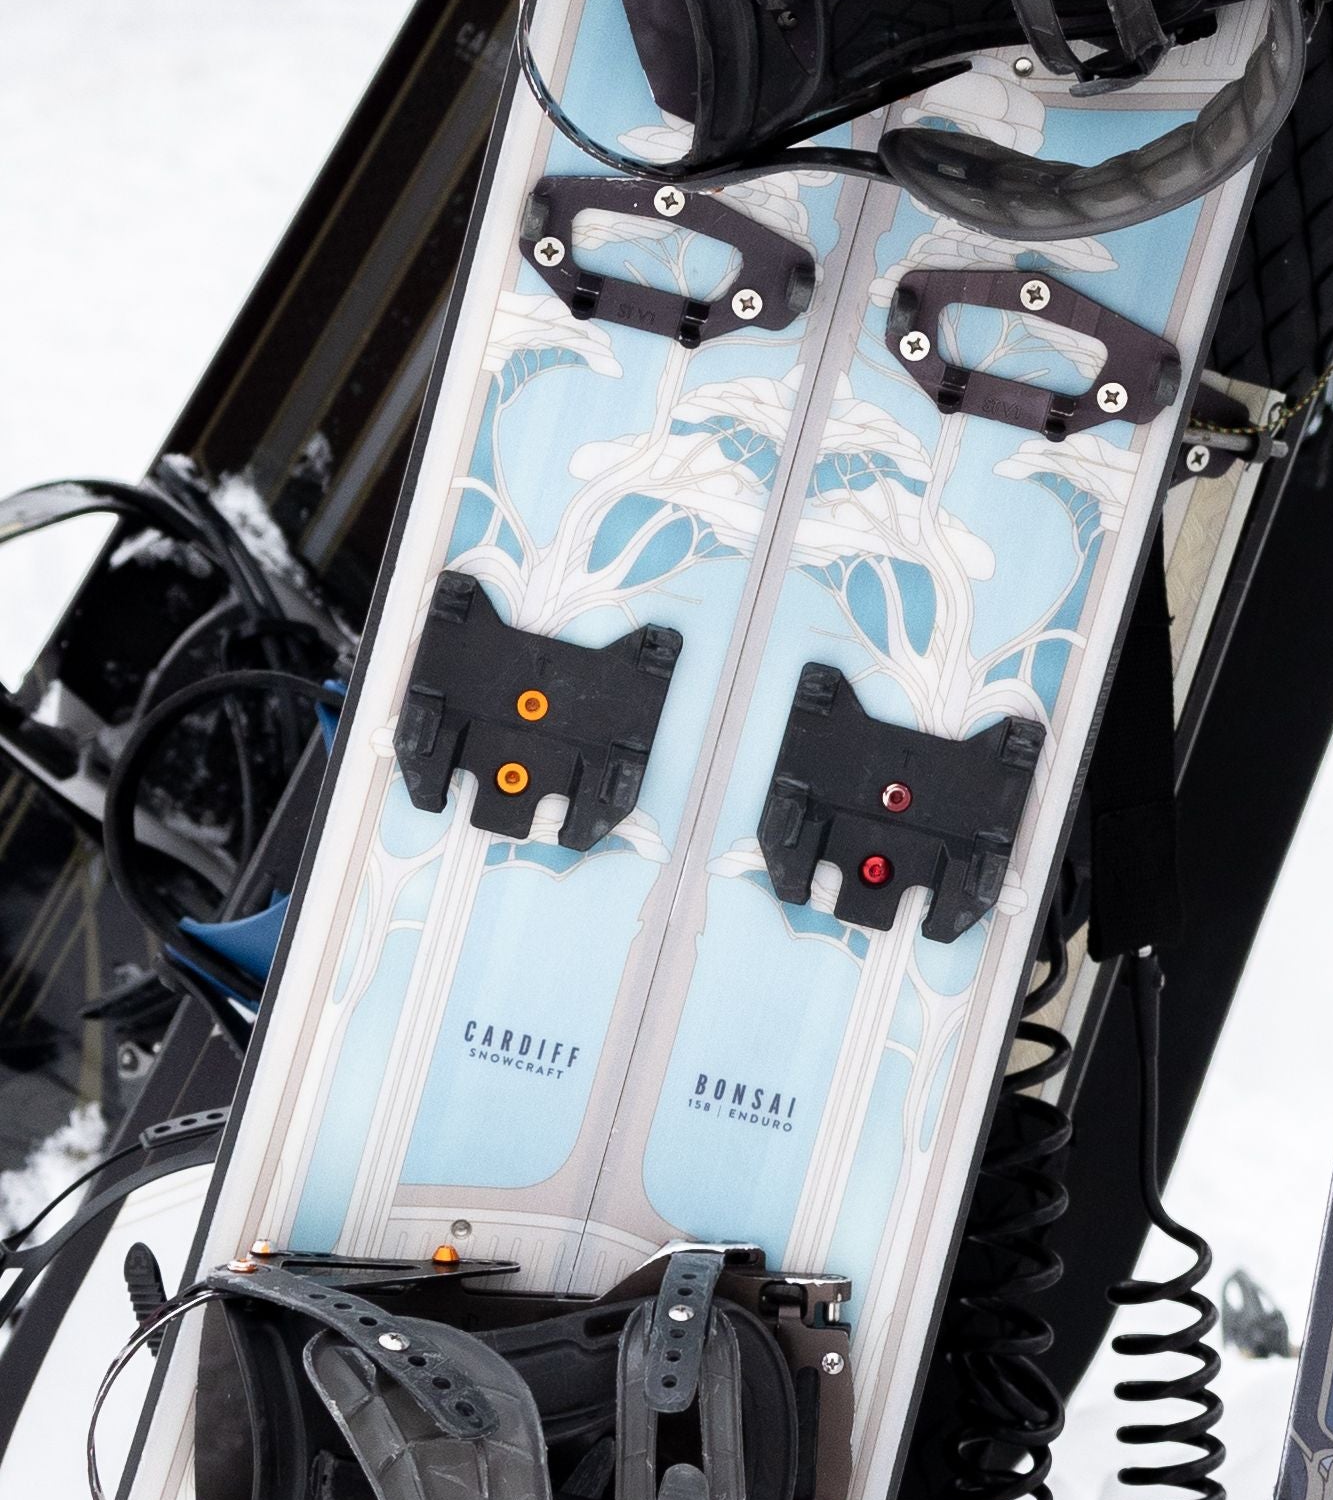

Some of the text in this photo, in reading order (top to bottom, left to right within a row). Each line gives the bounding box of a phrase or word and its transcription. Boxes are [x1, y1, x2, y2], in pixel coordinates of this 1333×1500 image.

[463, 1020, 581, 1069] CARDIFF
[468, 1047, 565, 1081] SNOWCRAFT
[687, 1098, 793, 1133] 158 ENDURO
[694, 1073, 797, 1119] BONSAI
